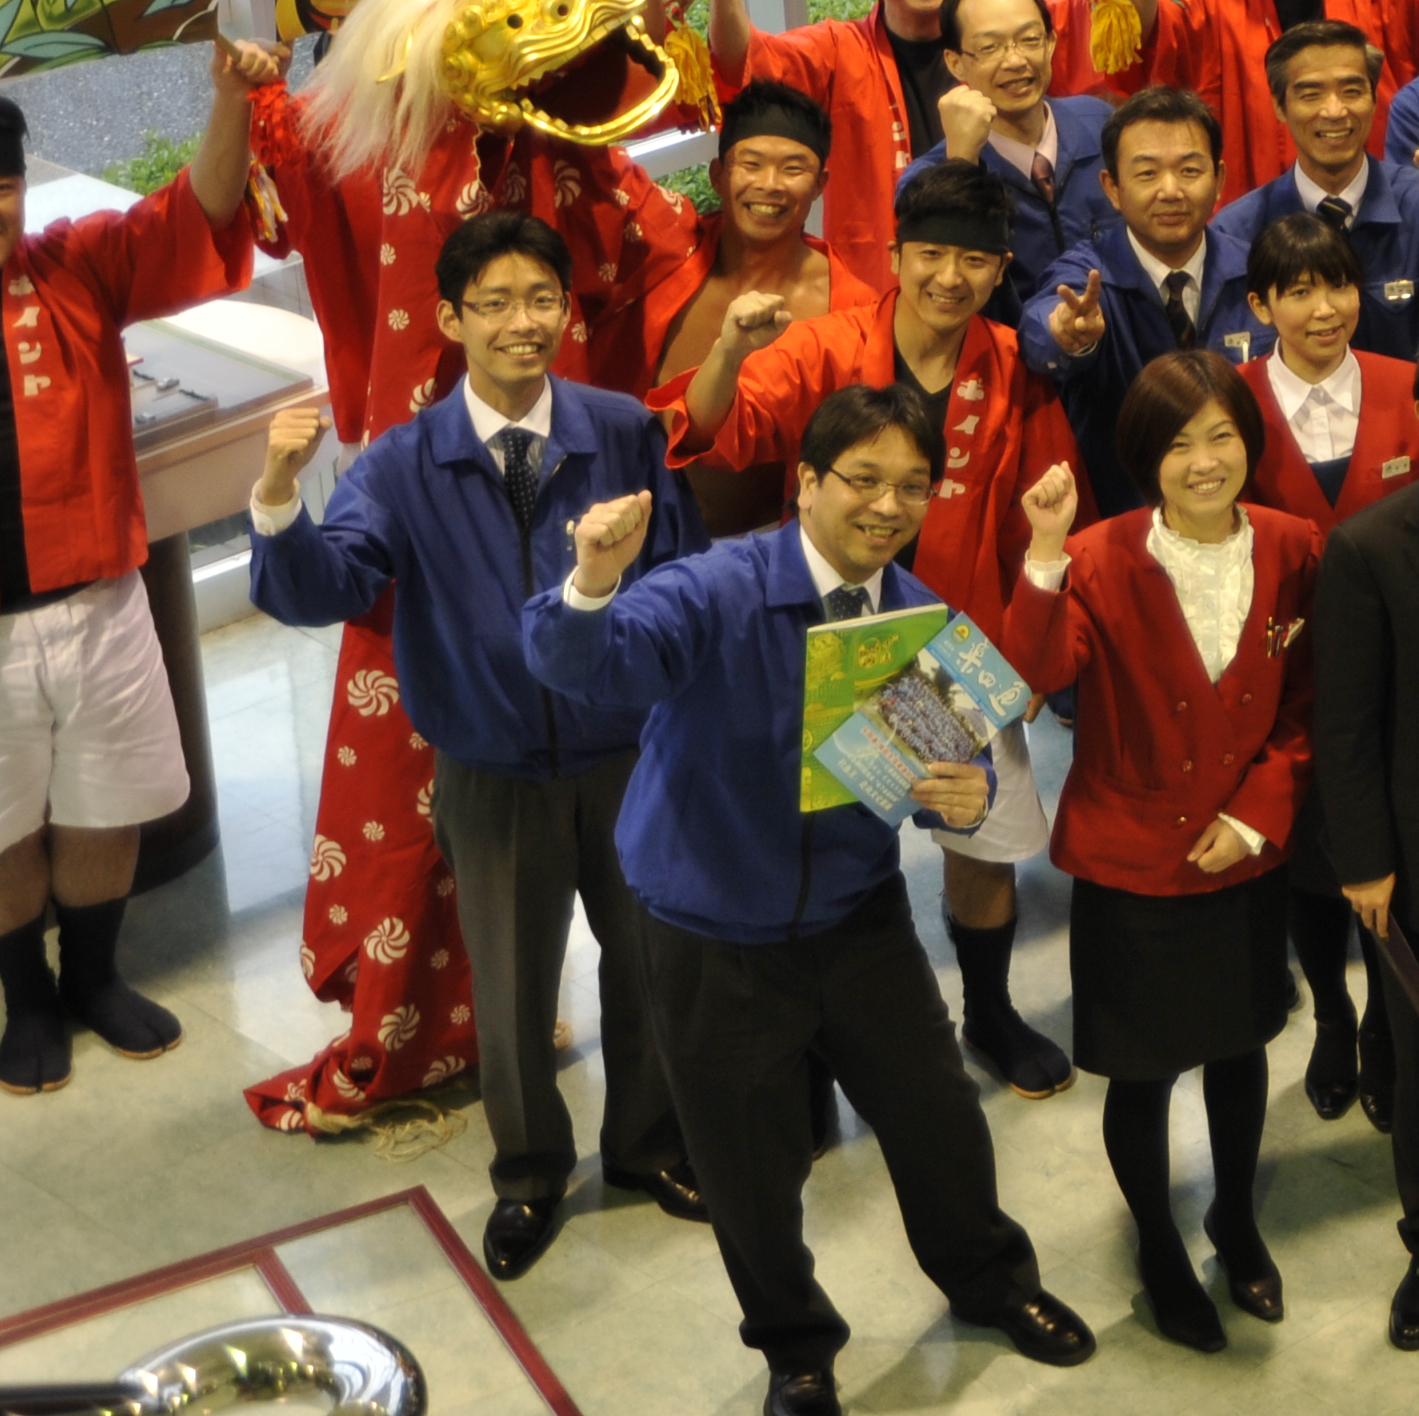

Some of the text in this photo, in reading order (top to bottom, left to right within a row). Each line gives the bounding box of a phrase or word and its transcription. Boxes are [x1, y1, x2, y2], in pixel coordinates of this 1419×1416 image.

[7, 274, 52, 397] ポイント
[938, 378, 985, 499] ポイント
